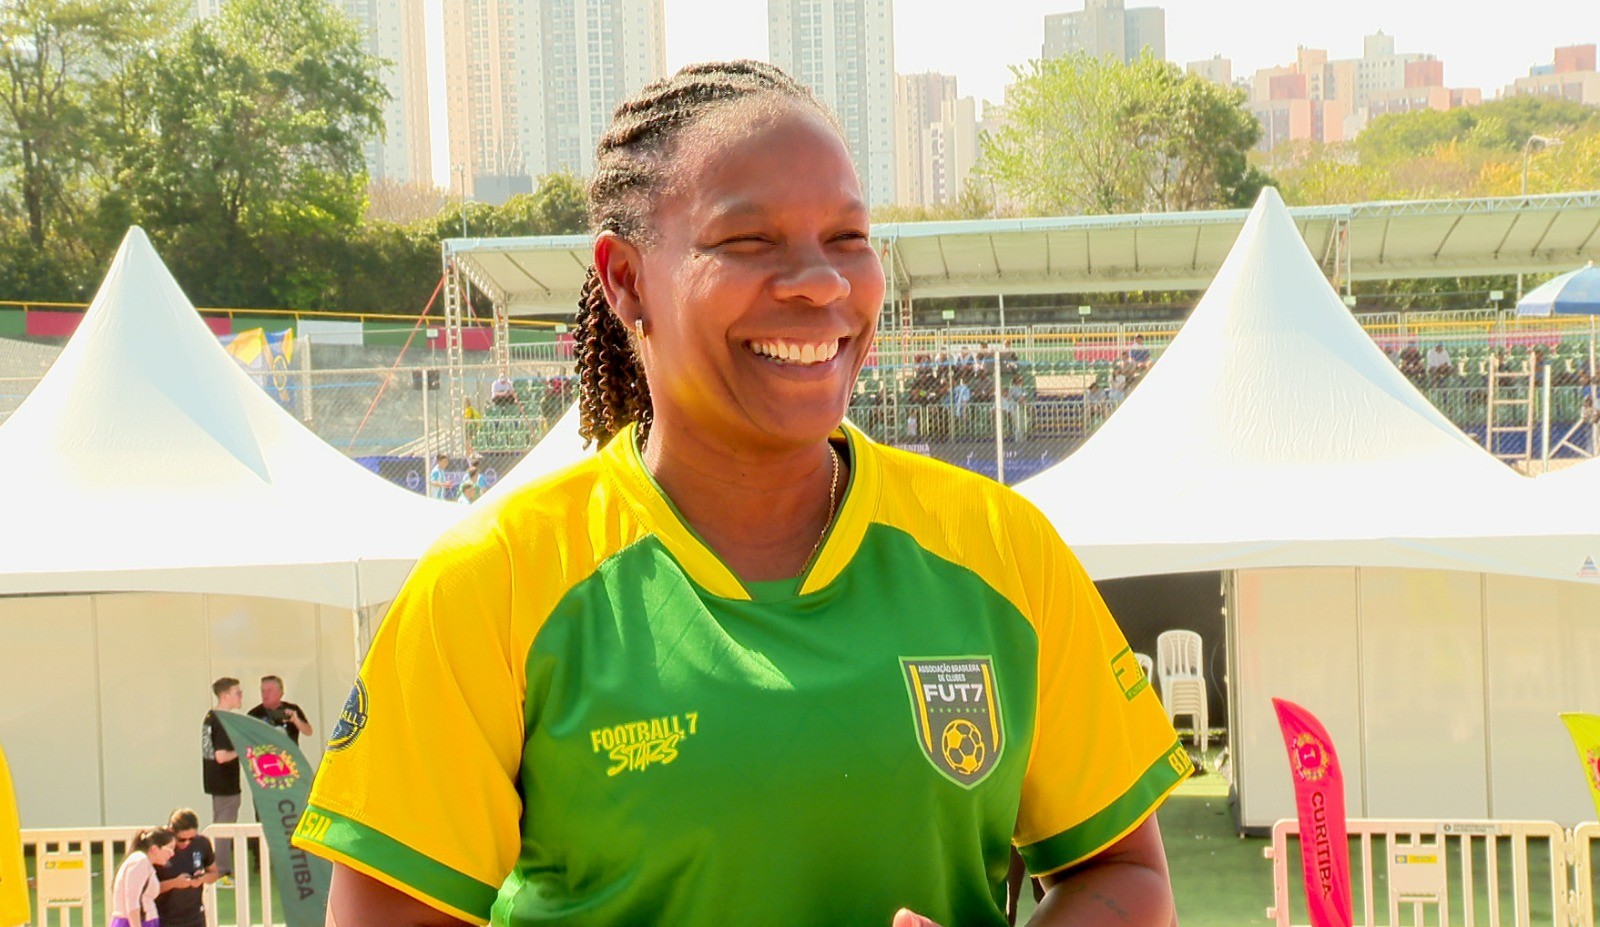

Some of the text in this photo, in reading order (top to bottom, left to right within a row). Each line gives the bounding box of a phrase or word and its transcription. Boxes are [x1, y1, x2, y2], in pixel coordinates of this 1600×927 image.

[923, 683, 983, 702] FUT7
[591, 711, 698, 753] FOOTBALL 7
[607, 734, 679, 777] STARS
[278, 799, 315, 901] CUTIBA
[1312, 792, 1332, 900] CURITIBA
